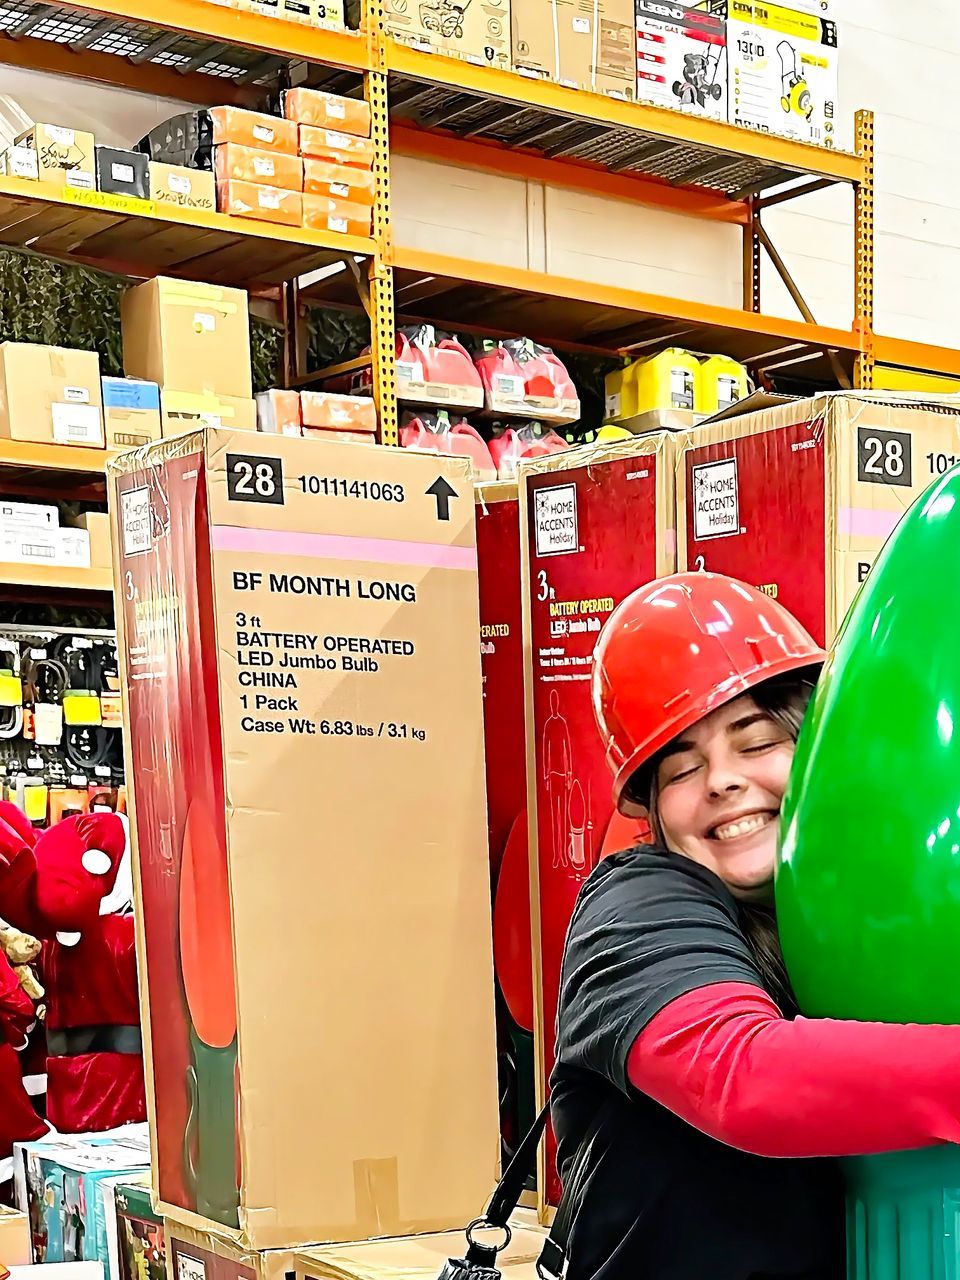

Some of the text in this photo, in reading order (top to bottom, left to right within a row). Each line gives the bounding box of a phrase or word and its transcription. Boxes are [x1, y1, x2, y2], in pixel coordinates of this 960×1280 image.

[863, 437, 904, 477] 28
[231, 461, 404, 502] 28 1011141063
[710, 478, 735, 493] HOME
[551, 502, 573, 515] HOME
[698, 495, 735, 512] ACCENTS
[539, 517, 573, 532] ACCENTS
[709, 511, 735, 527] Holiday
[233, 571, 417, 602] BF MONTH LONG
[550, 598, 614, 617] BATTERY OPERATED
[236, 612, 262, 628] 3 ft
[237, 632, 414, 656] BATTERY OPERATED
[237, 651, 378, 673] LED Jumbo Bulb
[238, 672, 298, 689] CHINA
[255, 695, 298, 711] Pack
[241, 717, 426, 741] Case Wt: 6.83 lbs 3.1 kg
